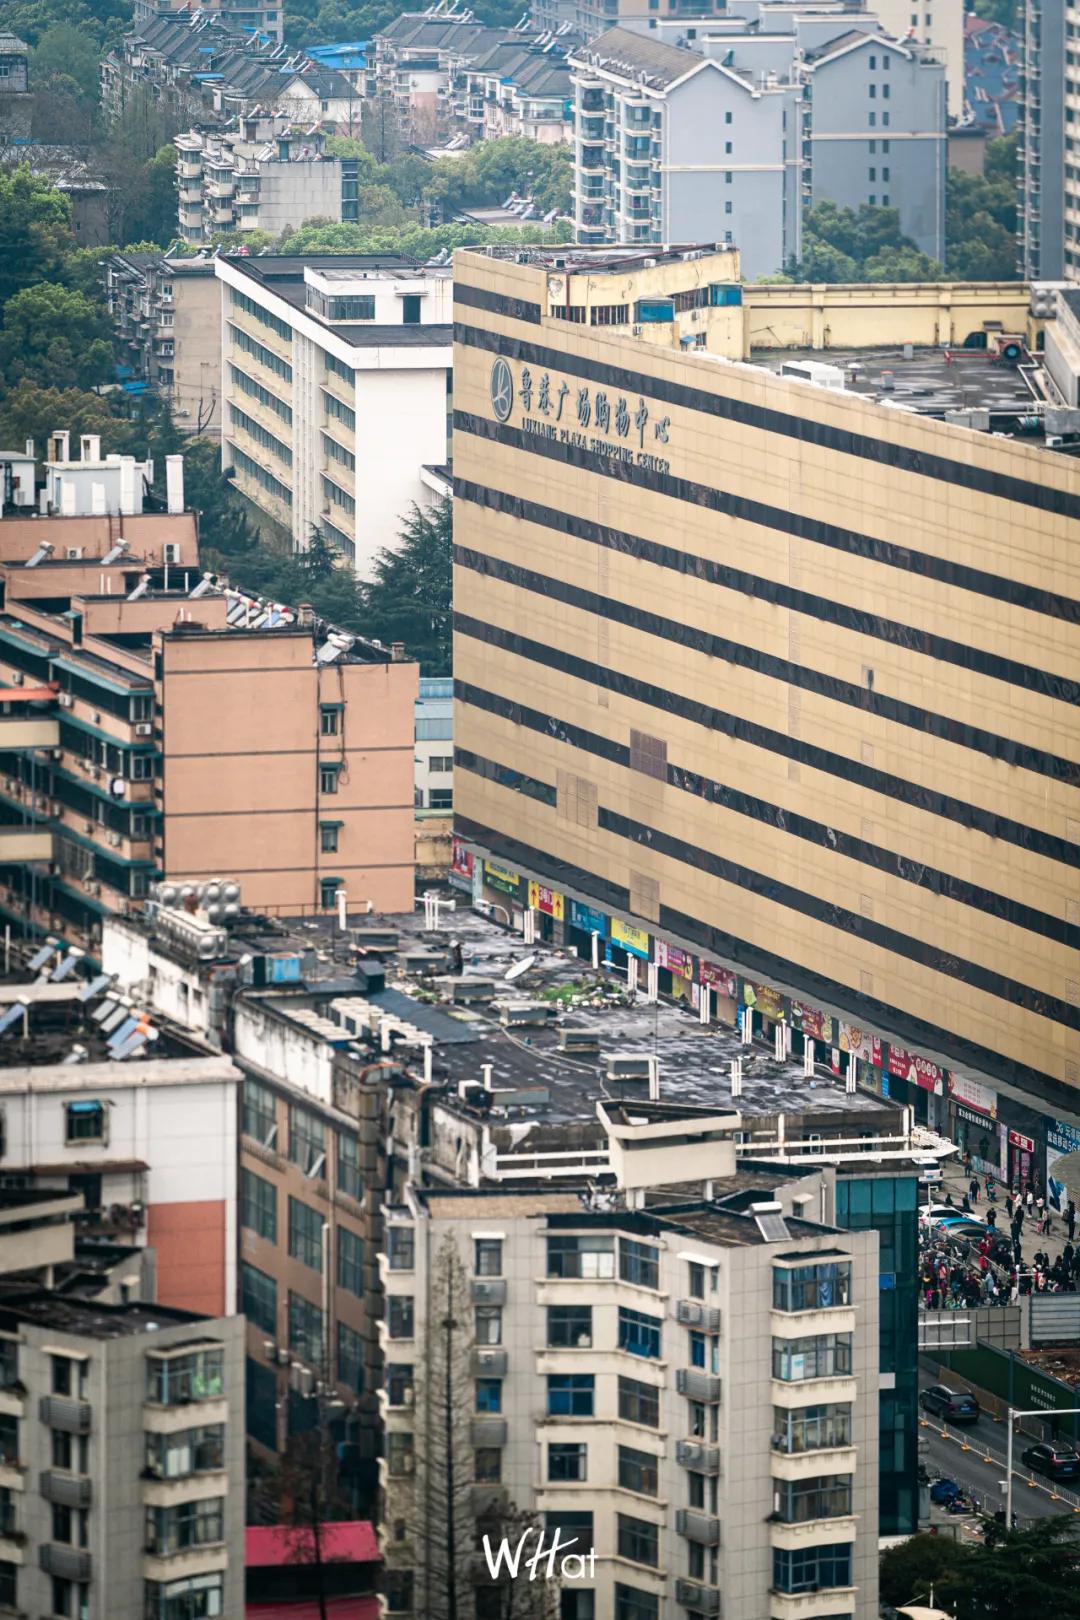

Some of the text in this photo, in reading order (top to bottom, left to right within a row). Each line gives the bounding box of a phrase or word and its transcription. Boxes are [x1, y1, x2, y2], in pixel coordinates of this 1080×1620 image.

[519, 367, 671, 448] 鲁巷广场购物中心
[522, 417, 670, 475] LUXIANG PLAZA SHOPPING CENTER
